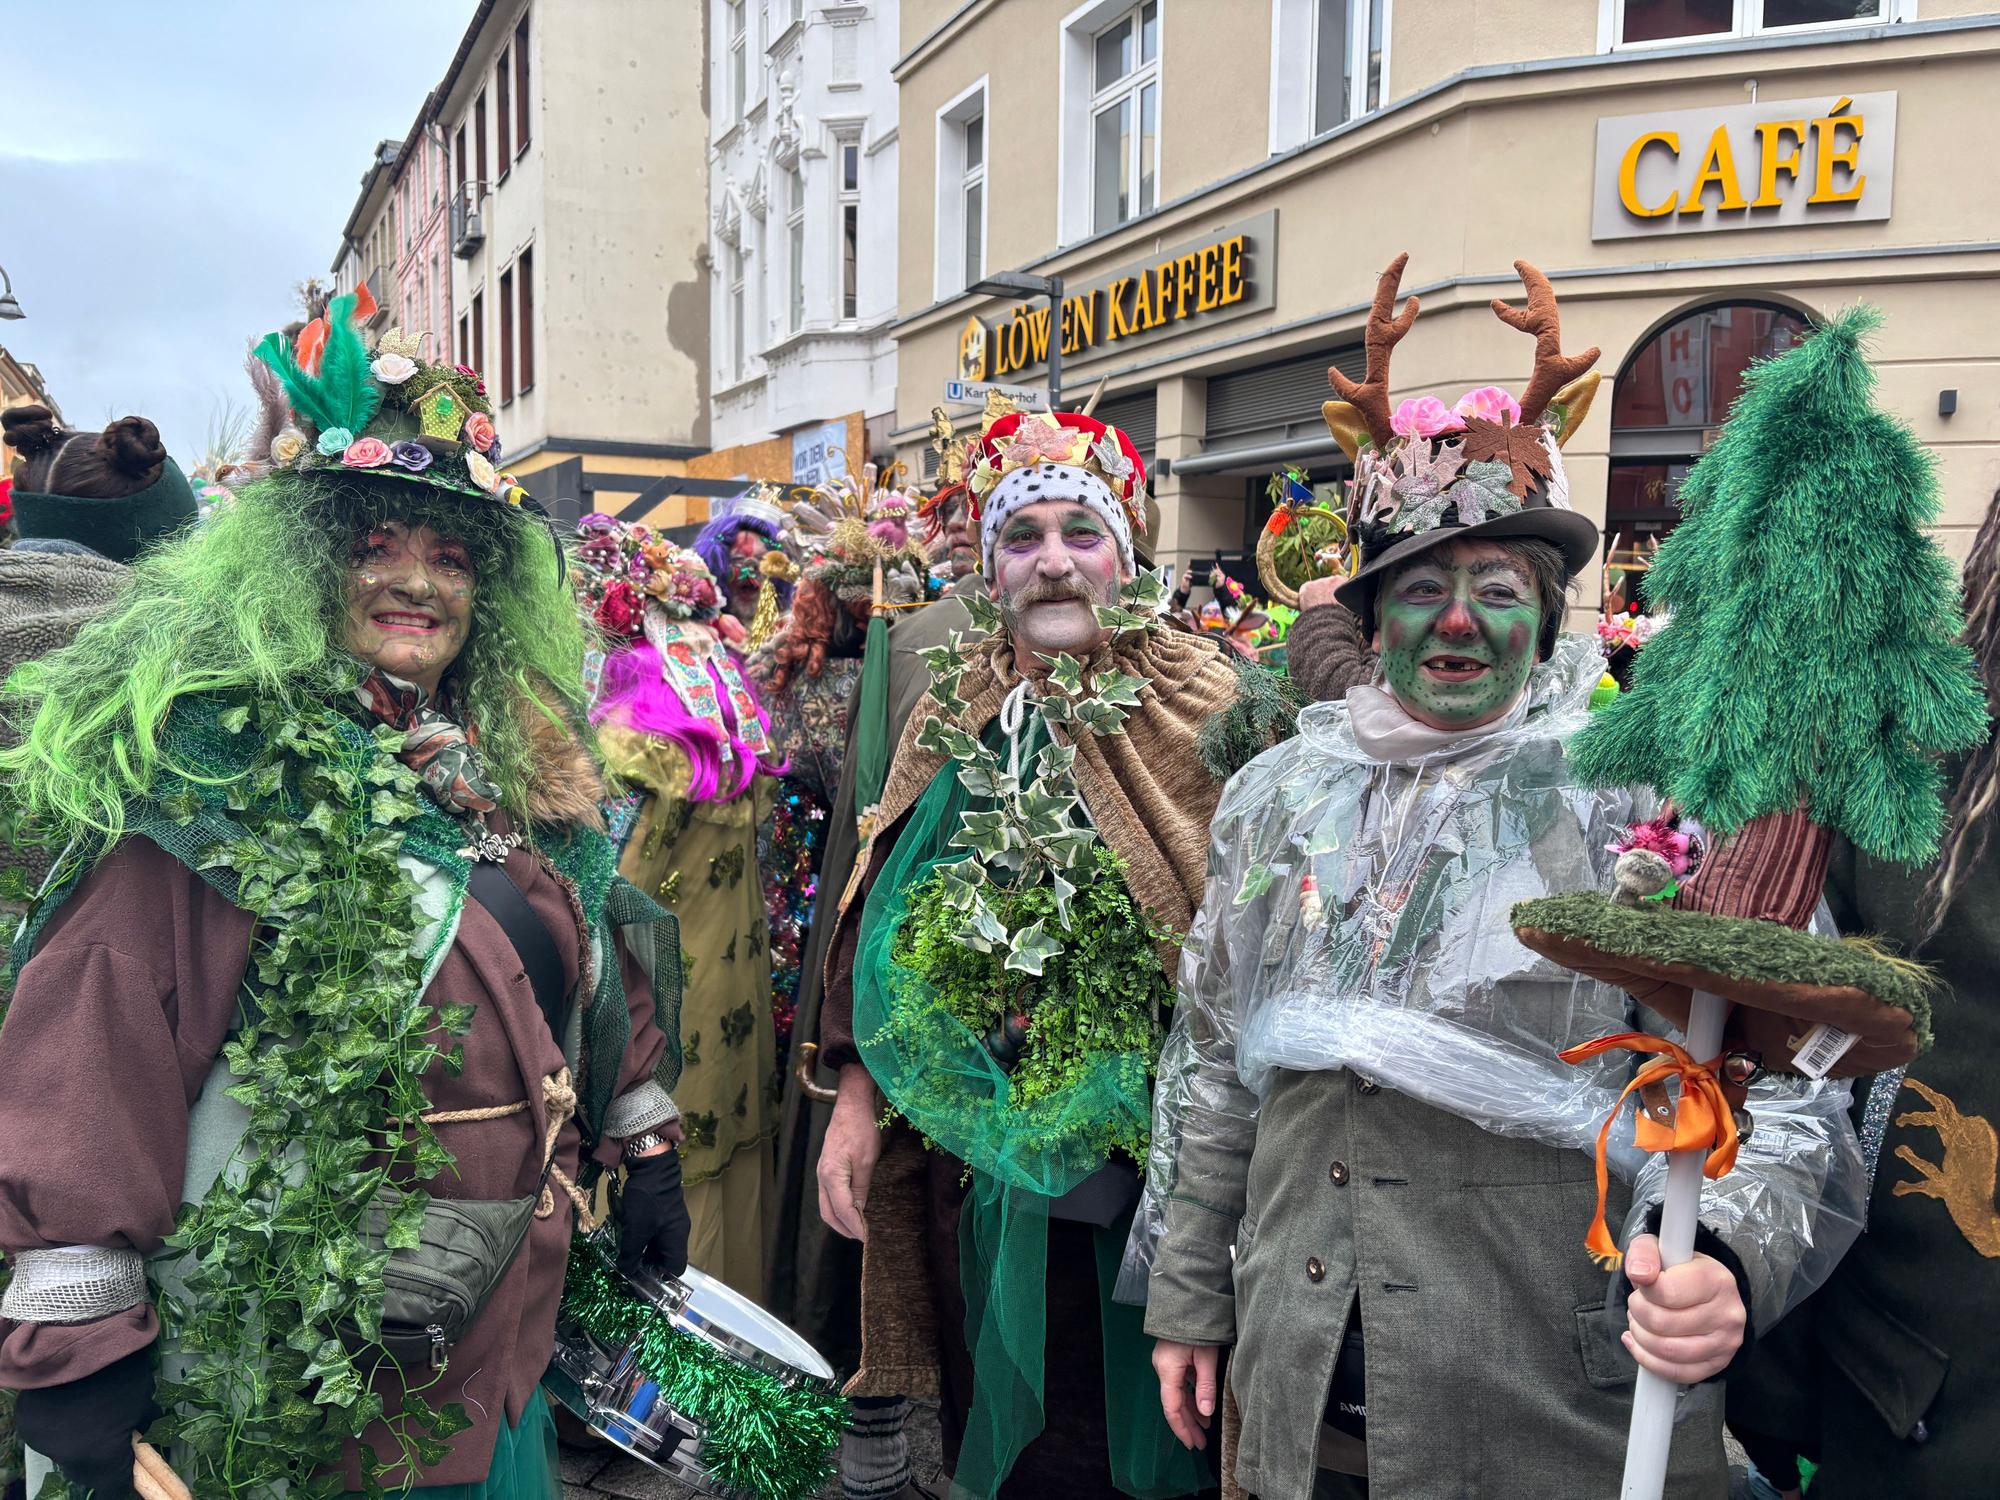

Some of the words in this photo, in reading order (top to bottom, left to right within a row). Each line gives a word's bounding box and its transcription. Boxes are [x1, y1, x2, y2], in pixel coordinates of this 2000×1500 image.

[1617, 95, 1867, 217] CAFÉ
[994, 289, 1098, 375] LÖWEN
[1106, 234, 1248, 341] KAFFEE
